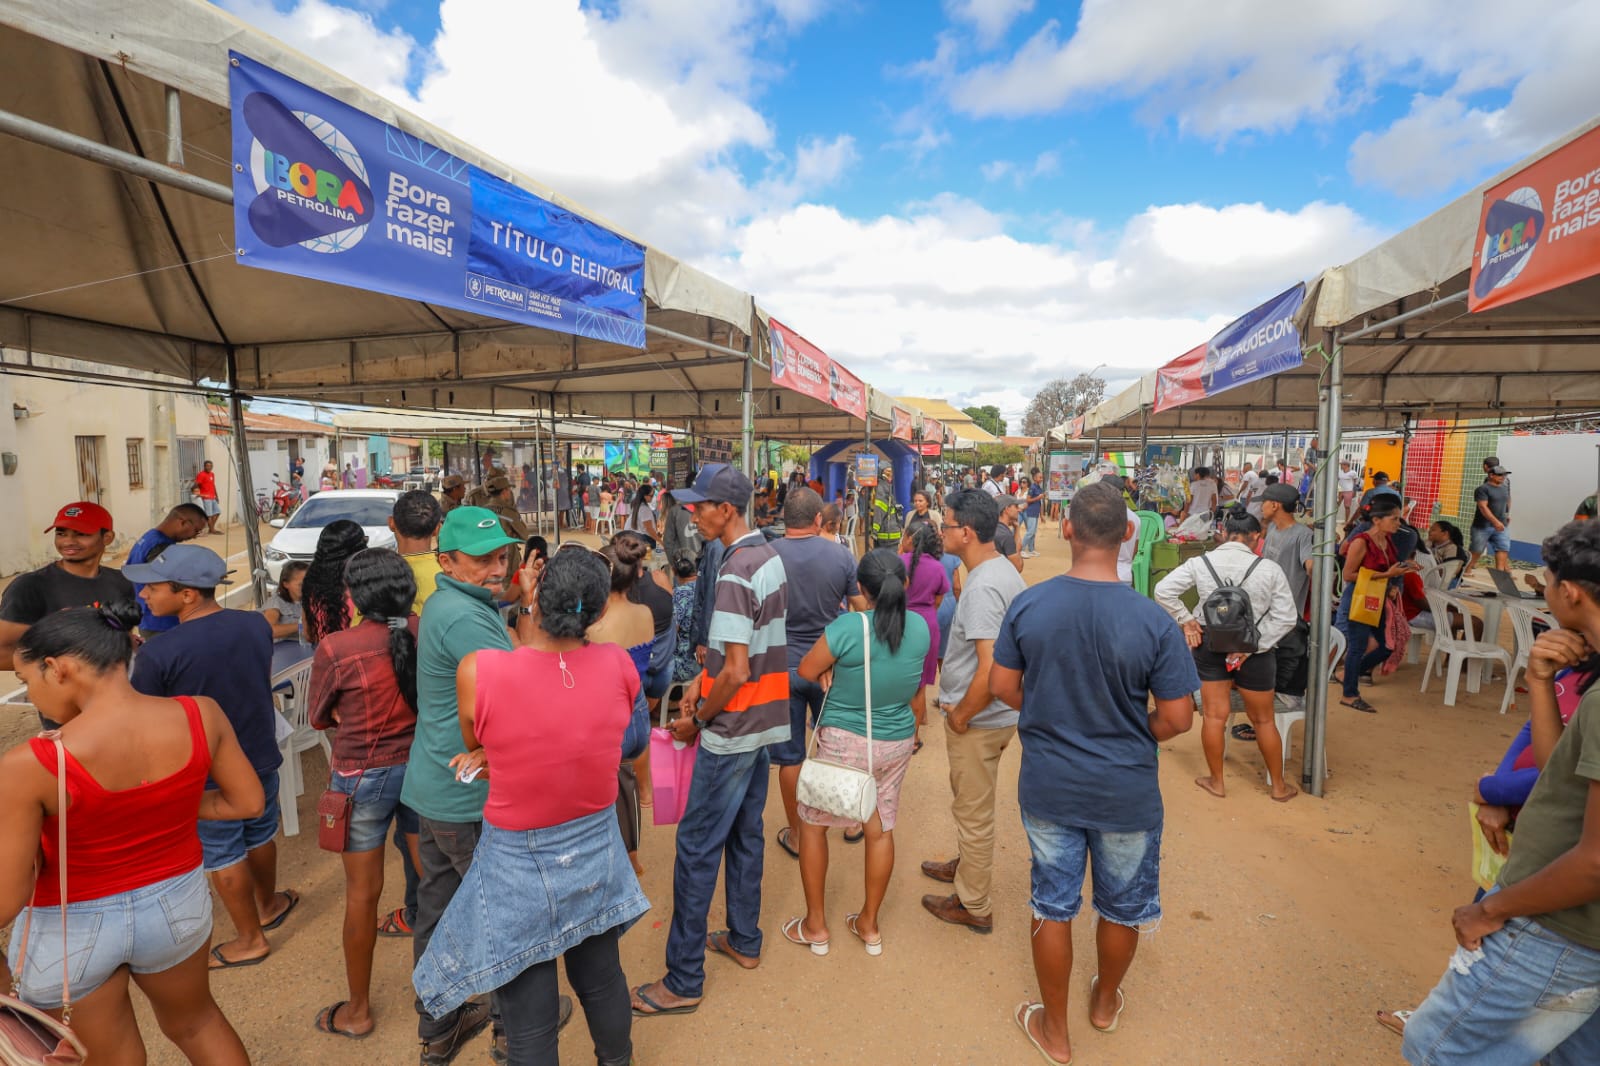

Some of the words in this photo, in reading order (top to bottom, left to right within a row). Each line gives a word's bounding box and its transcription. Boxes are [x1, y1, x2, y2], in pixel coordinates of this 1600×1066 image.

[264, 149, 365, 216] BORA
[388, 171, 451, 215] Bora
[277, 189, 356, 223] PETROLINA
[385, 194, 455, 235] fazer
[1552, 188, 1600, 224] faze
[387, 222, 453, 257] mais!
[1487, 216, 1536, 260] BORA
[1488, 242, 1529, 265] PETROLINA
[491, 221, 563, 267] TÍTULO
[571, 254, 636, 295] ELEITORAL
[485, 284, 524, 303] PETROLINA
